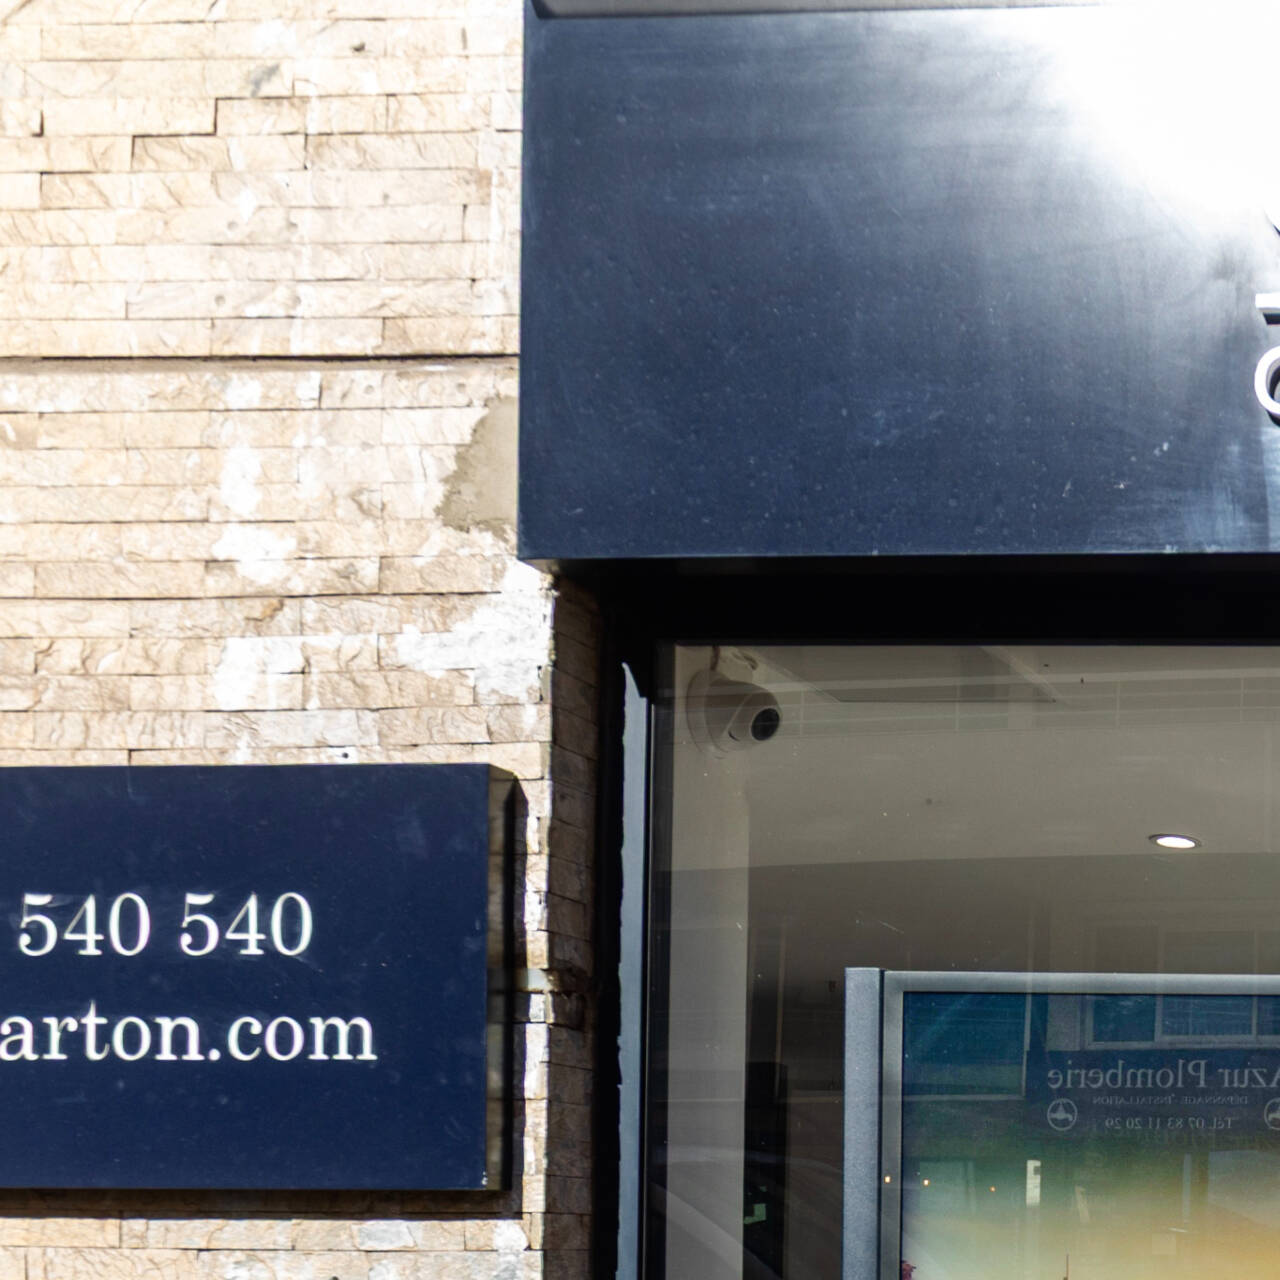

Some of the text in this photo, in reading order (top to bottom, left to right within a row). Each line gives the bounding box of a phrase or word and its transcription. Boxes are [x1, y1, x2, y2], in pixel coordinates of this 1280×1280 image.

[18, 891, 314, 957] 540 540
[0, 1000, 378, 1062] arton.com
